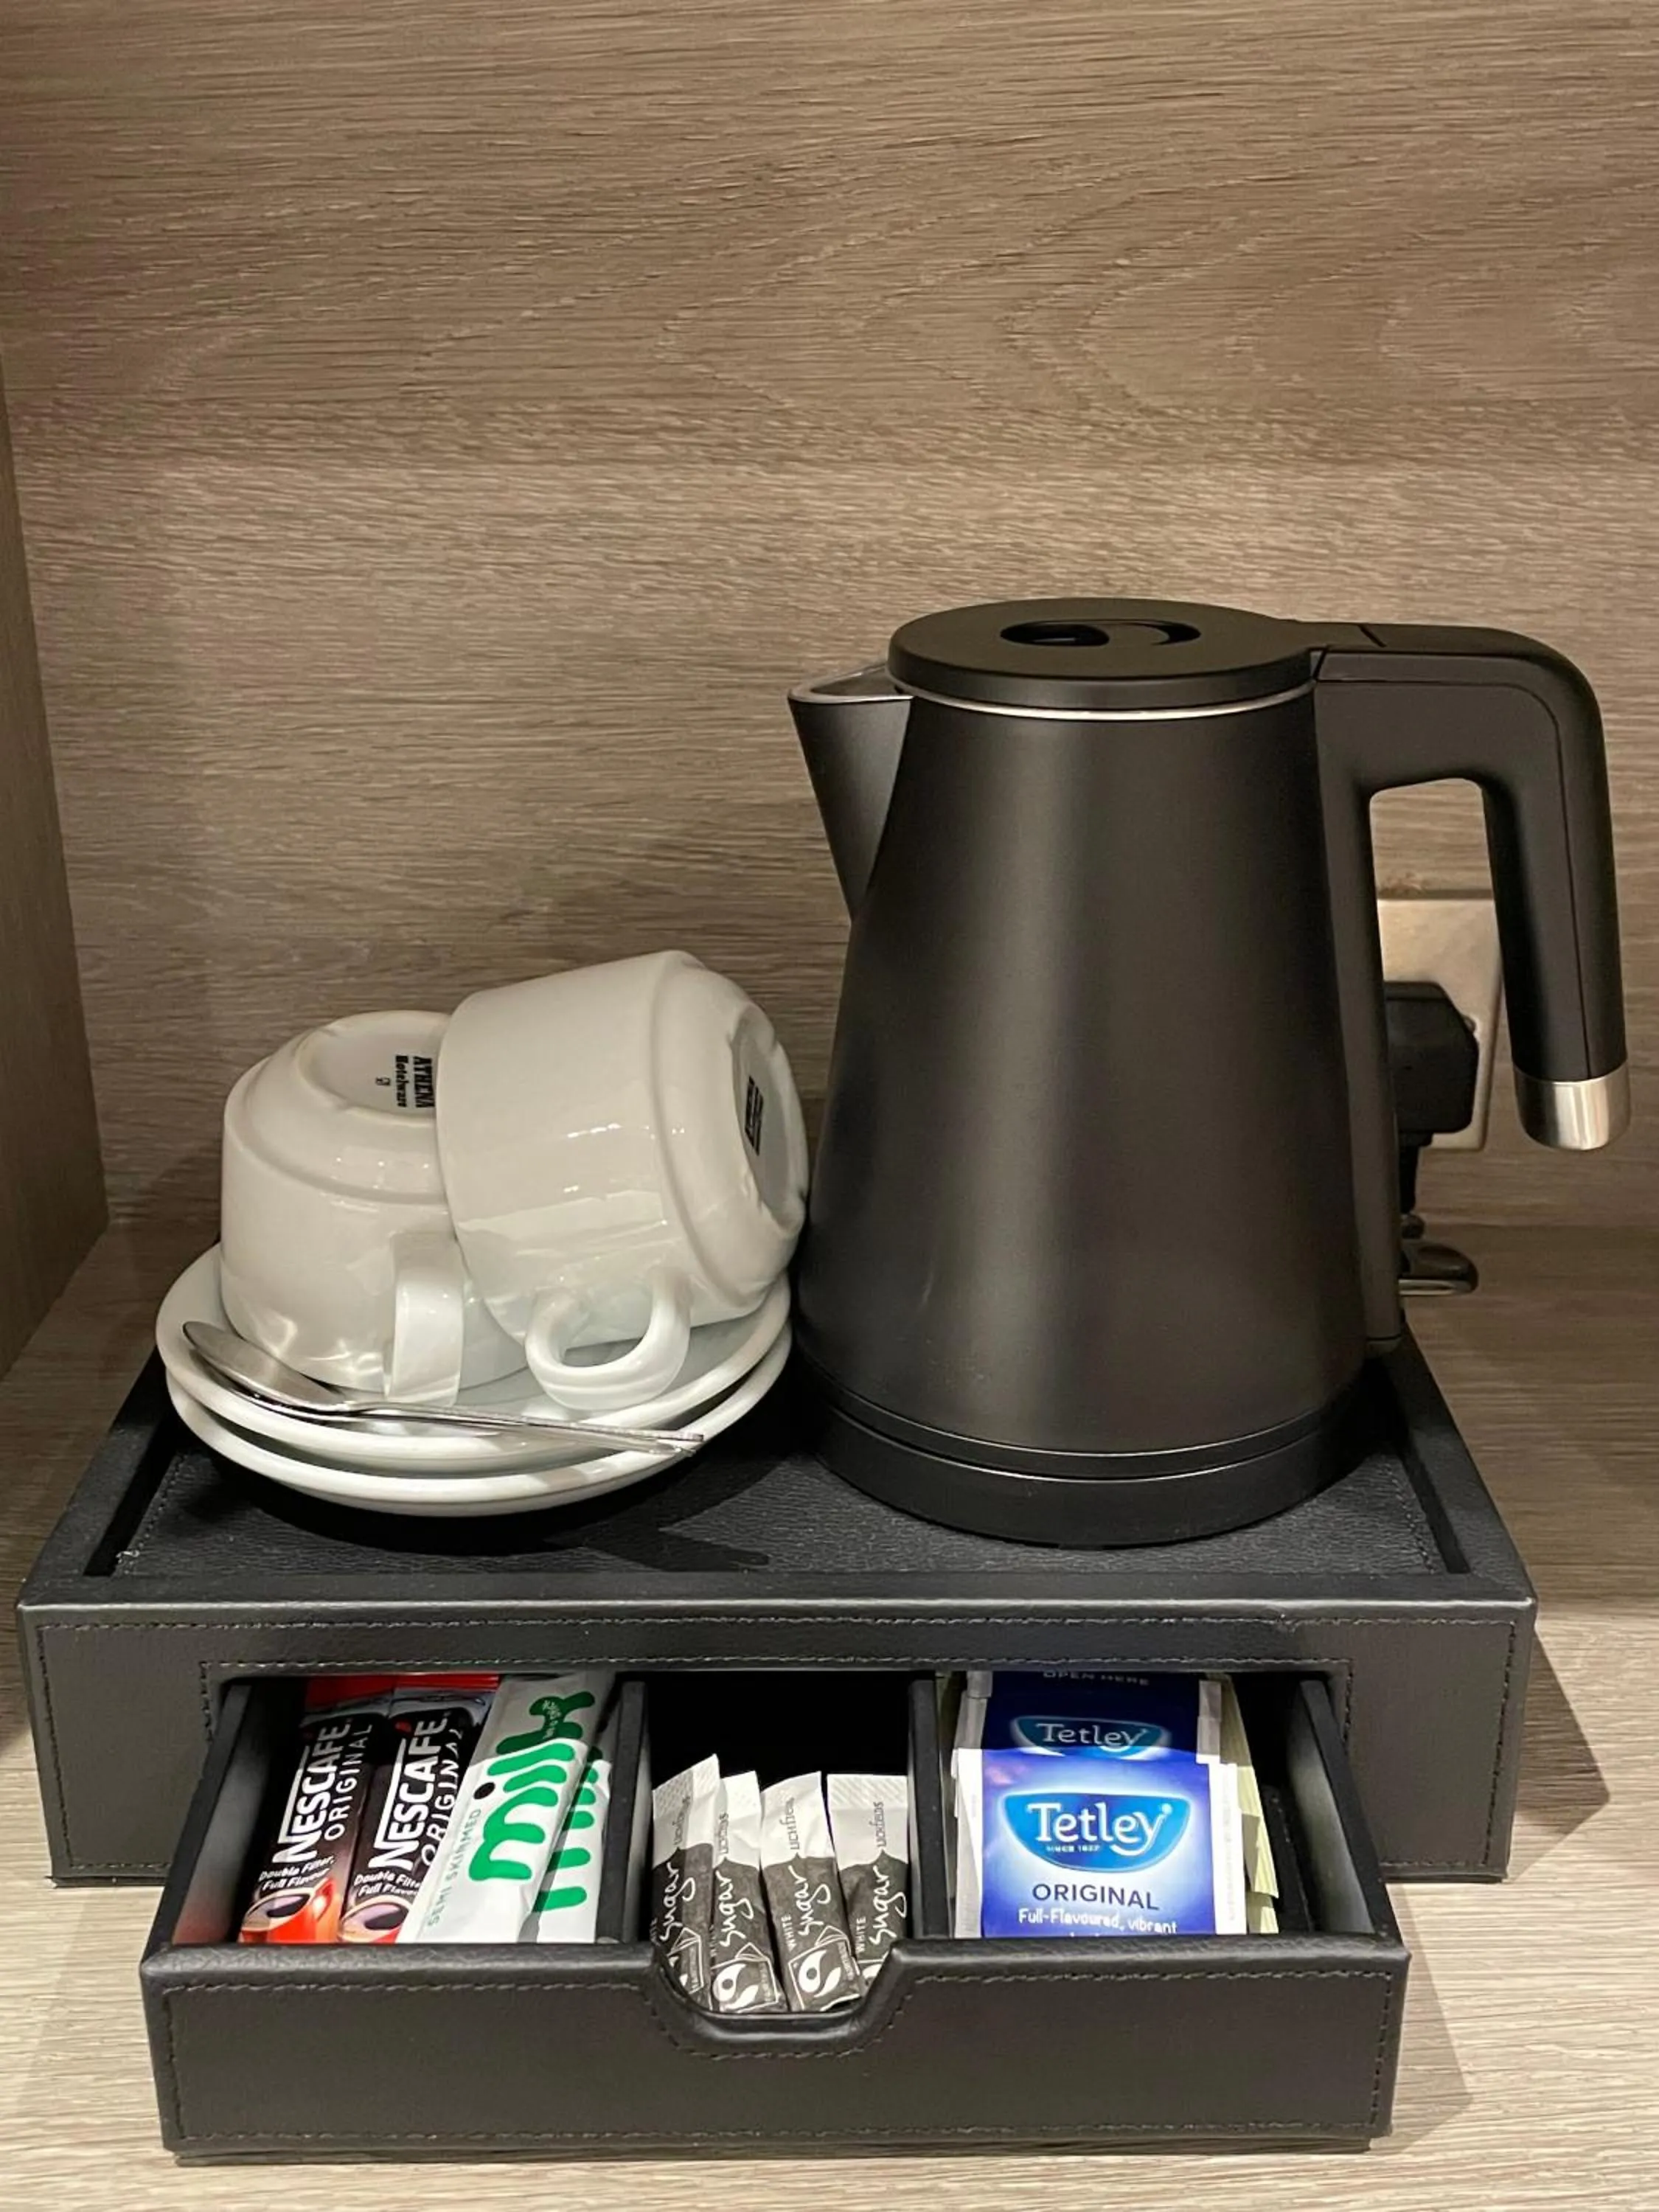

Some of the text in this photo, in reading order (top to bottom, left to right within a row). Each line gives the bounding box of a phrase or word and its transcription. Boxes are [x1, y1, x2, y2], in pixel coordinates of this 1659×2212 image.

[1035, 1723, 1147, 1752] Tetley
[324, 1724, 372, 1841] ORIGINAL
[421, 1728, 463, 1865] ORIGINAL
[1026, 1801, 1172, 1857] Tetley
[259, 1866, 300, 1881] Double
[262, 1877, 287, 1891] Full
[354, 1871, 395, 1886] Double
[358, 1883, 380, 1896] Full
[427, 1886, 452, 1926] SEMI
[659, 1862, 696, 1941] sugar
[715, 1870, 754, 1947] sugar
[787, 1865, 831, 1936] sugar
[869, 1865, 907, 1945] sugar
[1032, 1883, 1160, 1911] ORIGINAL
[781, 1914, 796, 1952] WHITE
[855, 1917, 866, 1953] WHITE
[1127, 1915, 1178, 1934] vibrant
